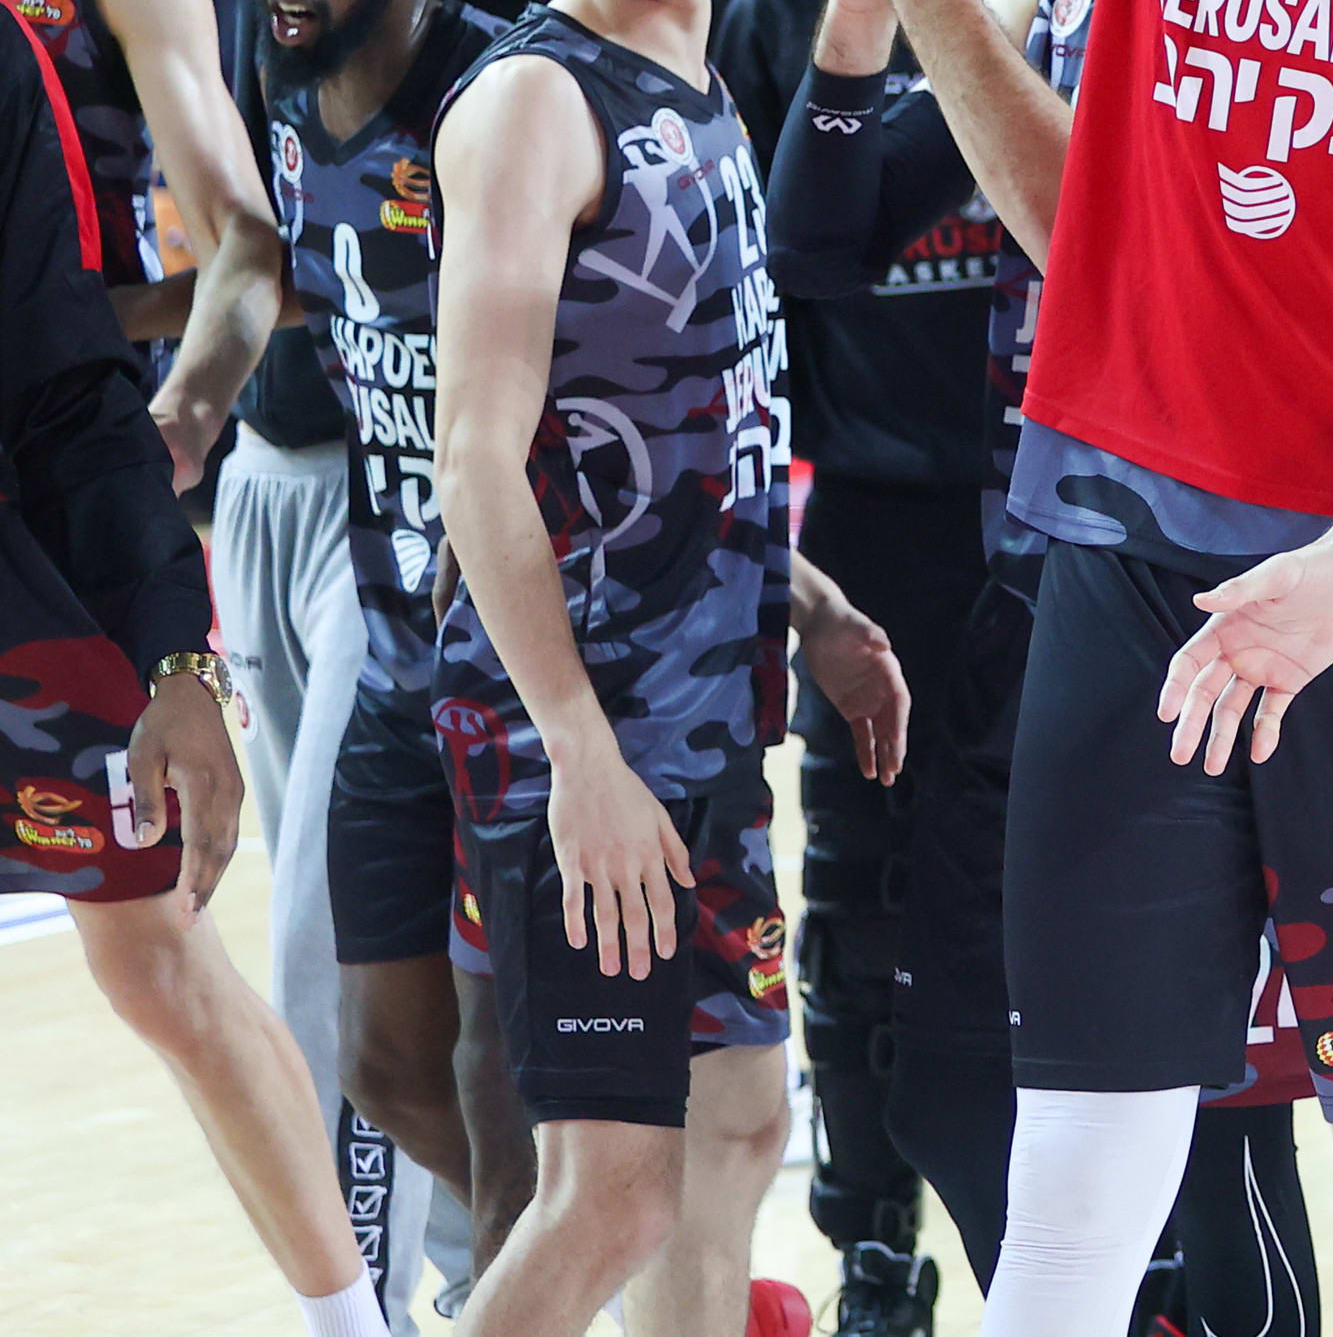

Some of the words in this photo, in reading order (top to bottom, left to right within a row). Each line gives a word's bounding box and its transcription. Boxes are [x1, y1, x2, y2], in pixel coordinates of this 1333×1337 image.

[390, 205, 429, 228] Winn
[333, 222, 380, 324] 0
[330, 314, 437, 391] HAPOE
[557, 1018, 645, 1033] GIVOVA
